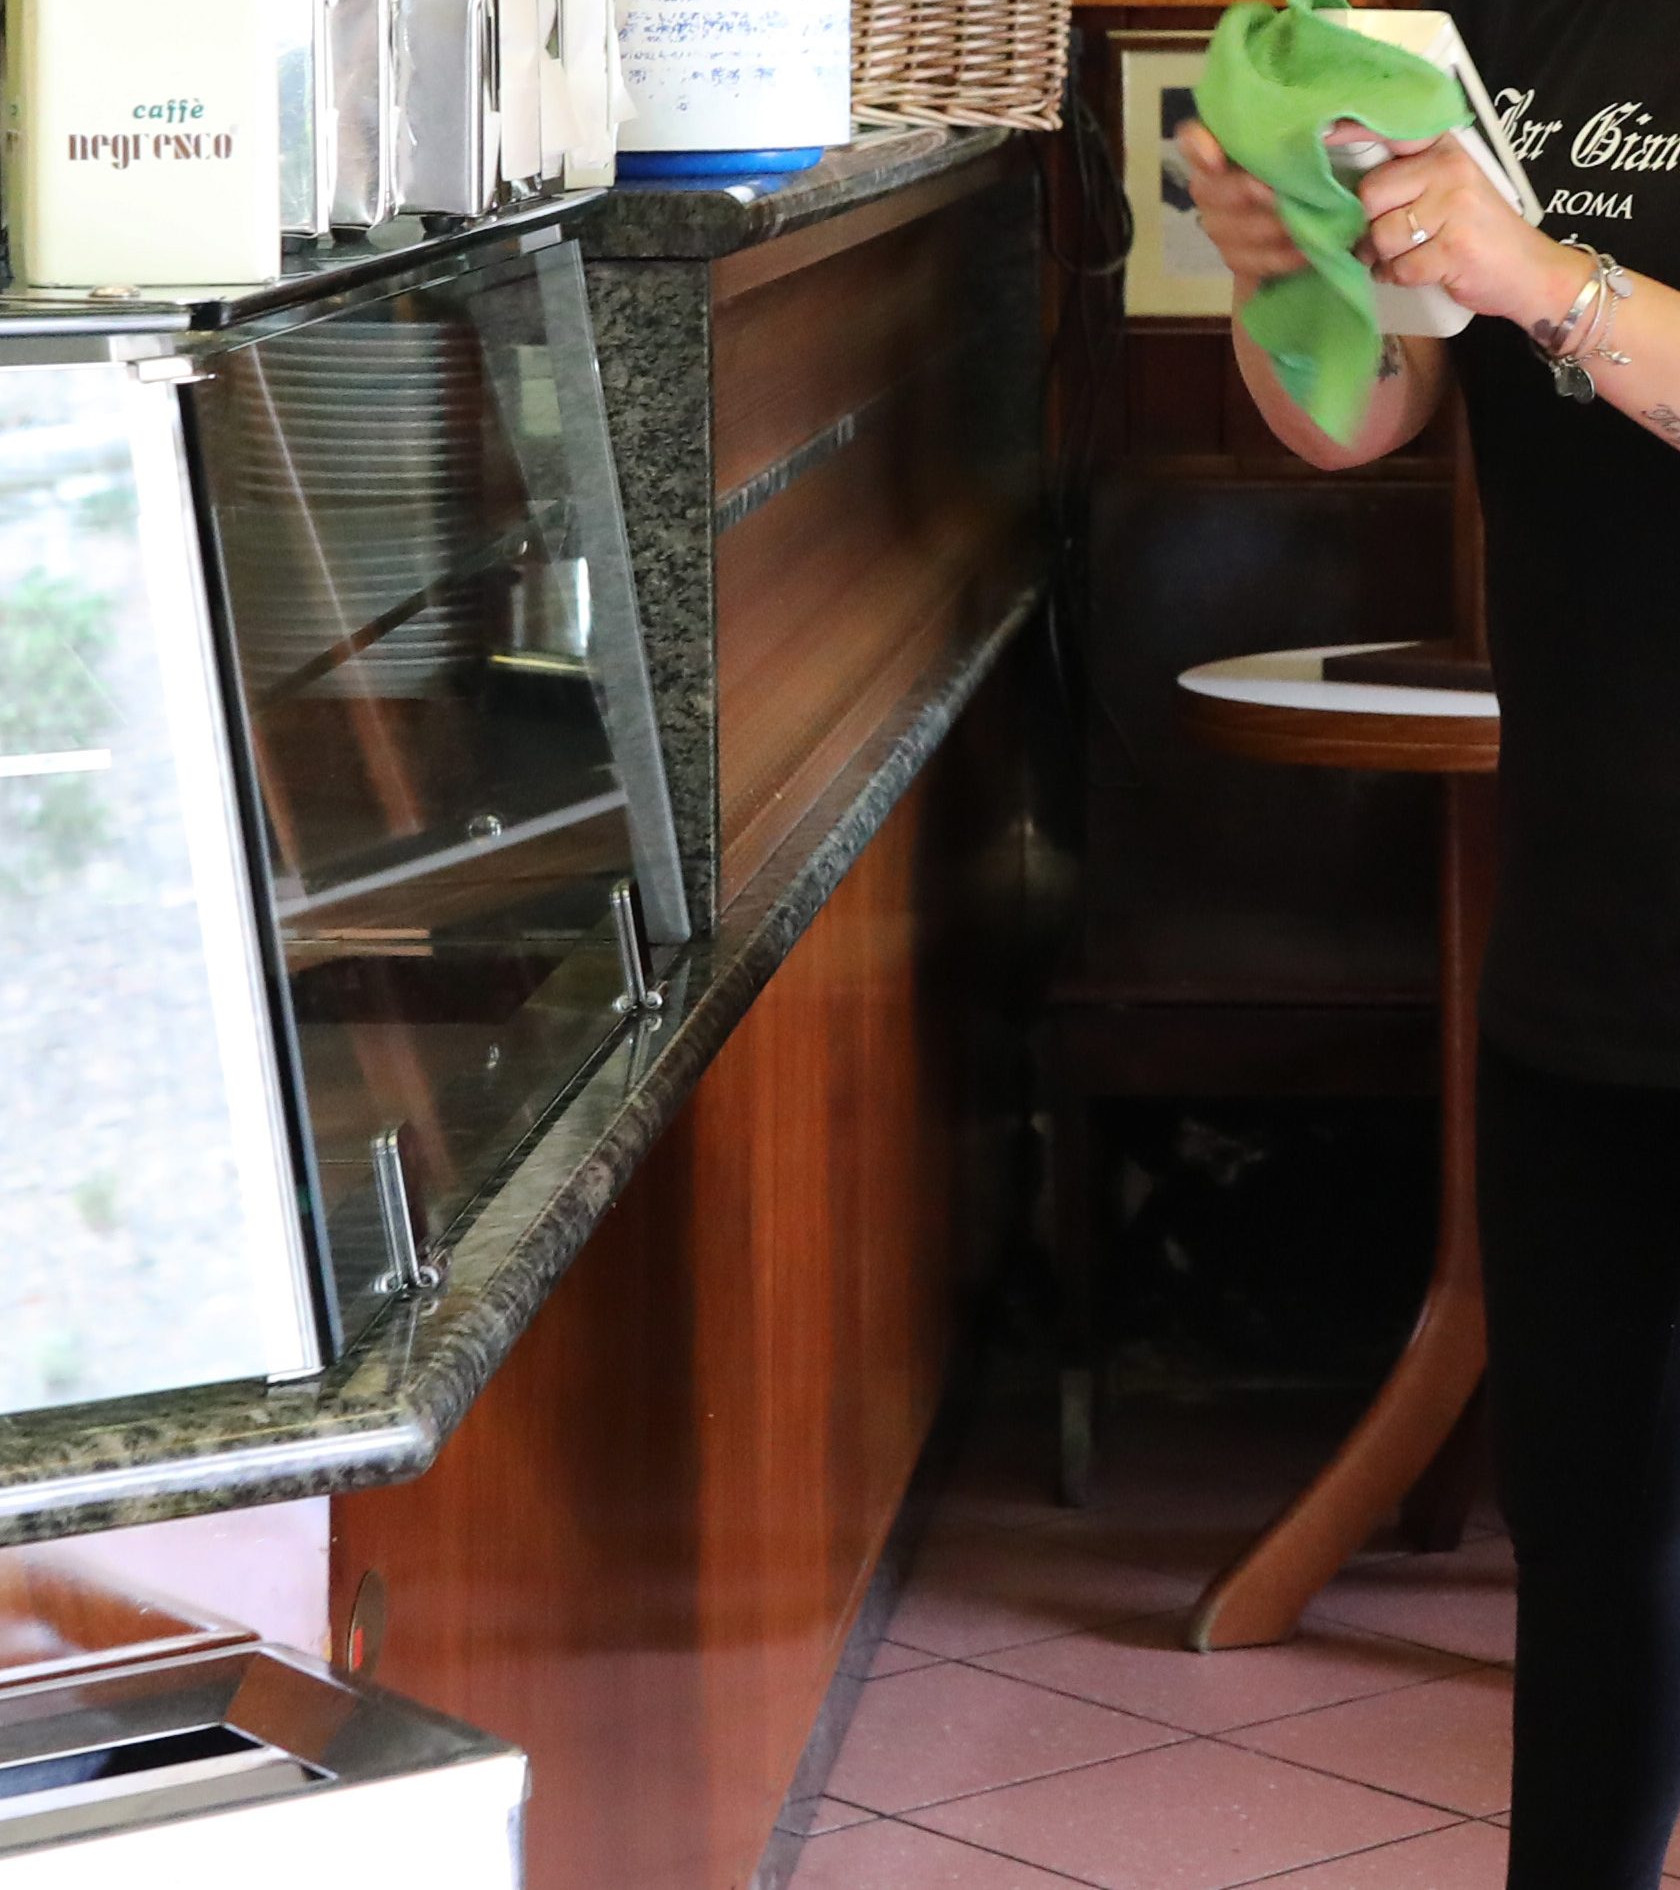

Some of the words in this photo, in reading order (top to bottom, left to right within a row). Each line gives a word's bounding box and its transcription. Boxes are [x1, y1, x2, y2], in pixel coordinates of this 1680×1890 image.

[132, 98, 205, 124] caffè
[68, 132, 233, 170] negresco
[1545, 189, 1635, 221] ROMA
